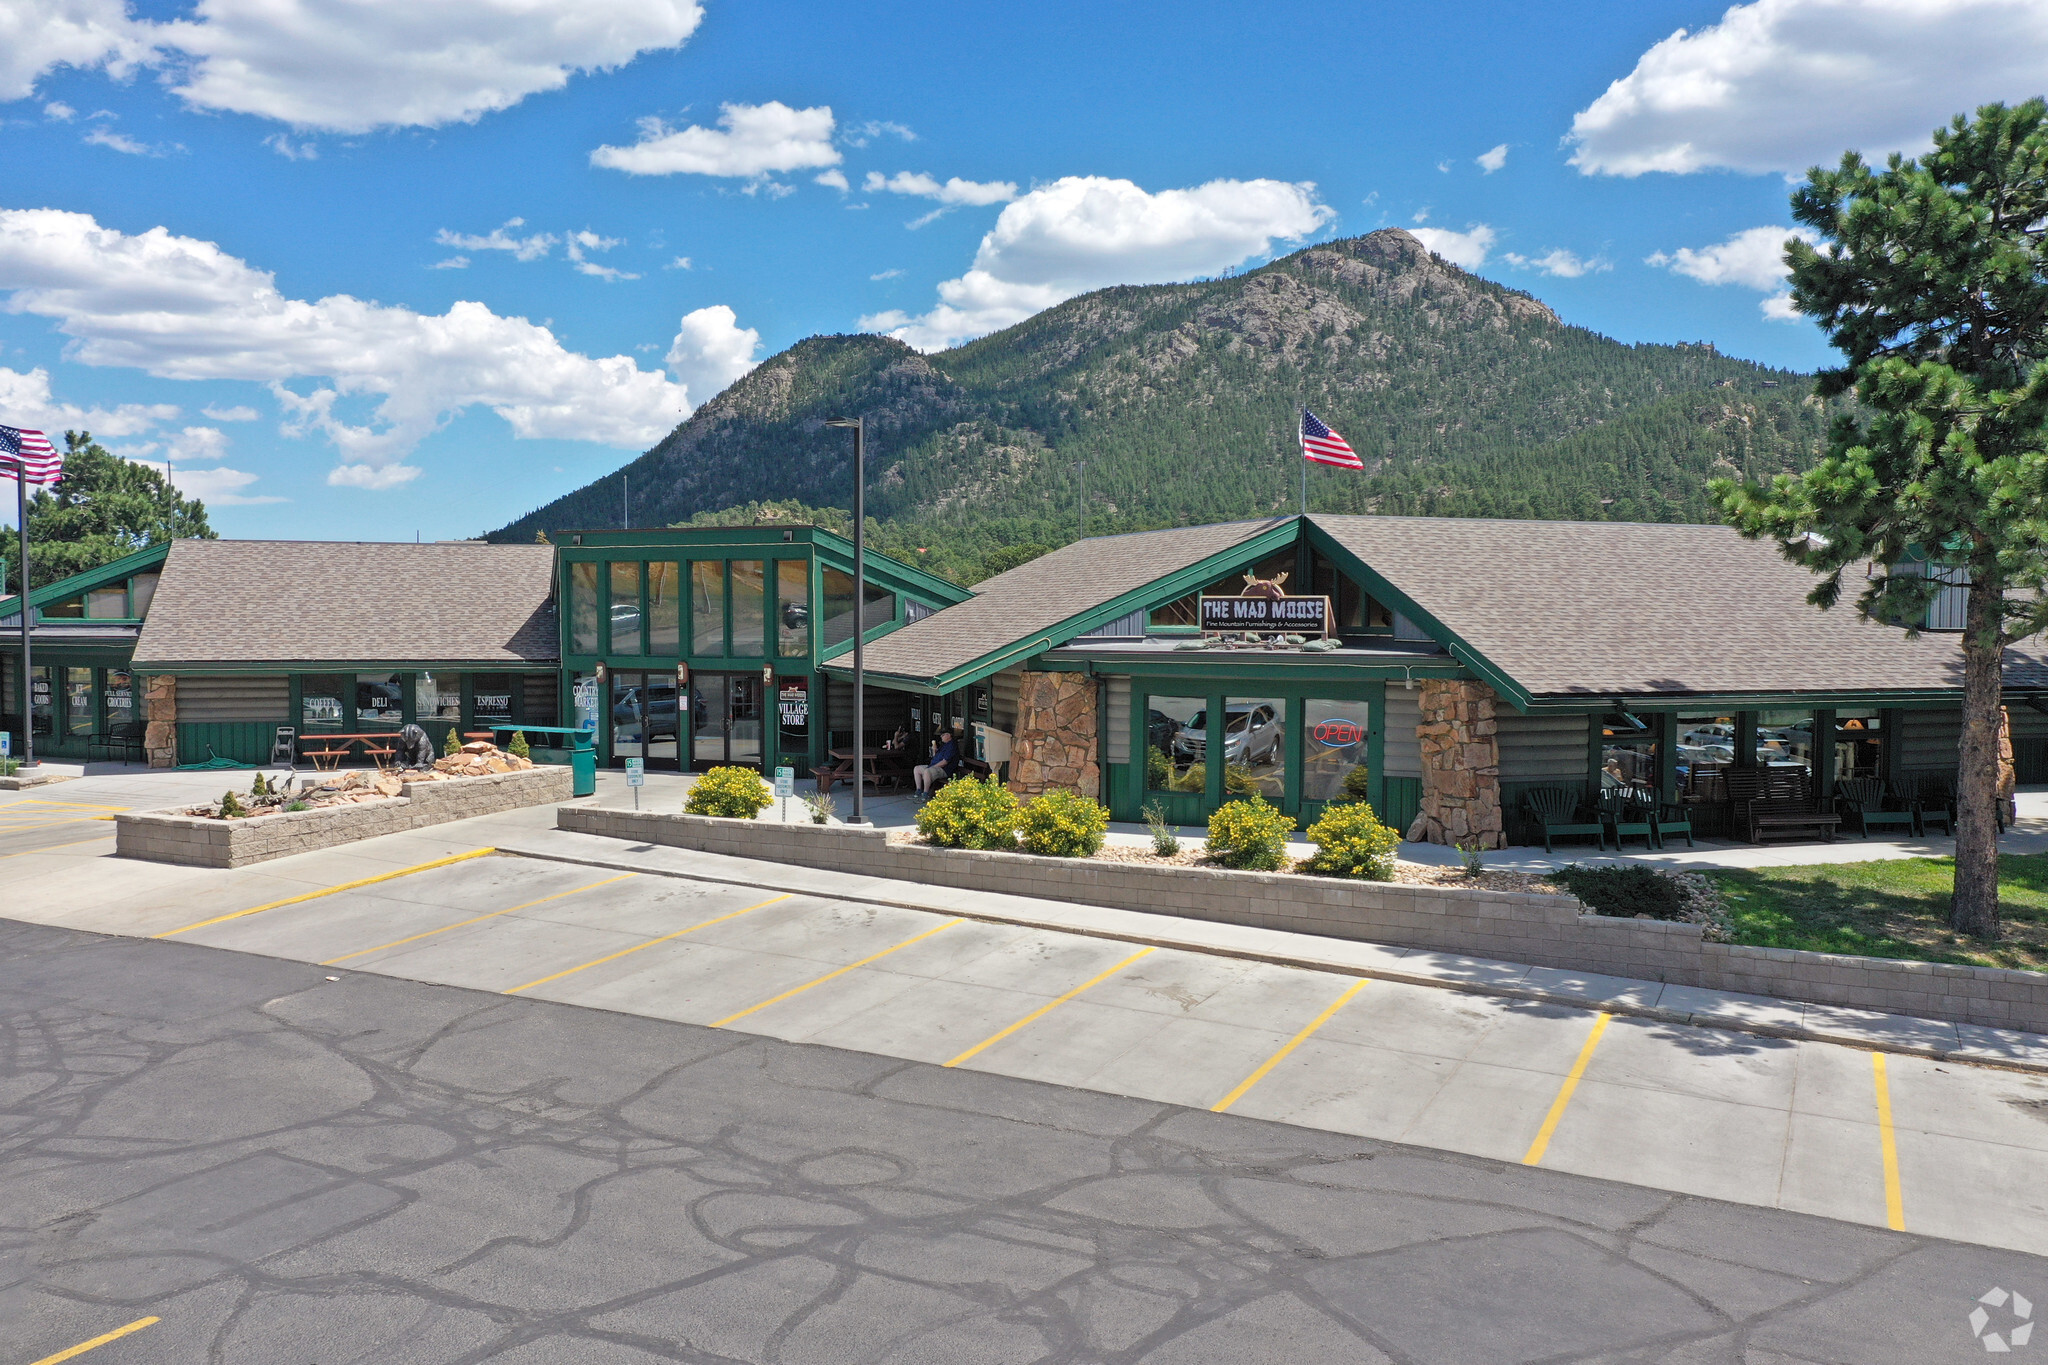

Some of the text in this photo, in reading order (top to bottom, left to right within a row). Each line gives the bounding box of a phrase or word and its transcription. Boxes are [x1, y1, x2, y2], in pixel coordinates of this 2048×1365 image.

[1203, 601, 1324, 619] THE MAD MOOSE
[1245, 620, 1277, 629] Furnishings
[72, 696, 87, 706] CREAM
[309, 698, 336, 708] COFFEE
[371, 697, 388, 708] DELI
[417, 696, 460, 707] SANDWICHES
[477, 695, 509, 706] ESPRESSO
[778, 703, 809, 715] VILLAGE
[782, 714, 805, 726] STORE
[1313, 723, 1364, 743] OPEN
